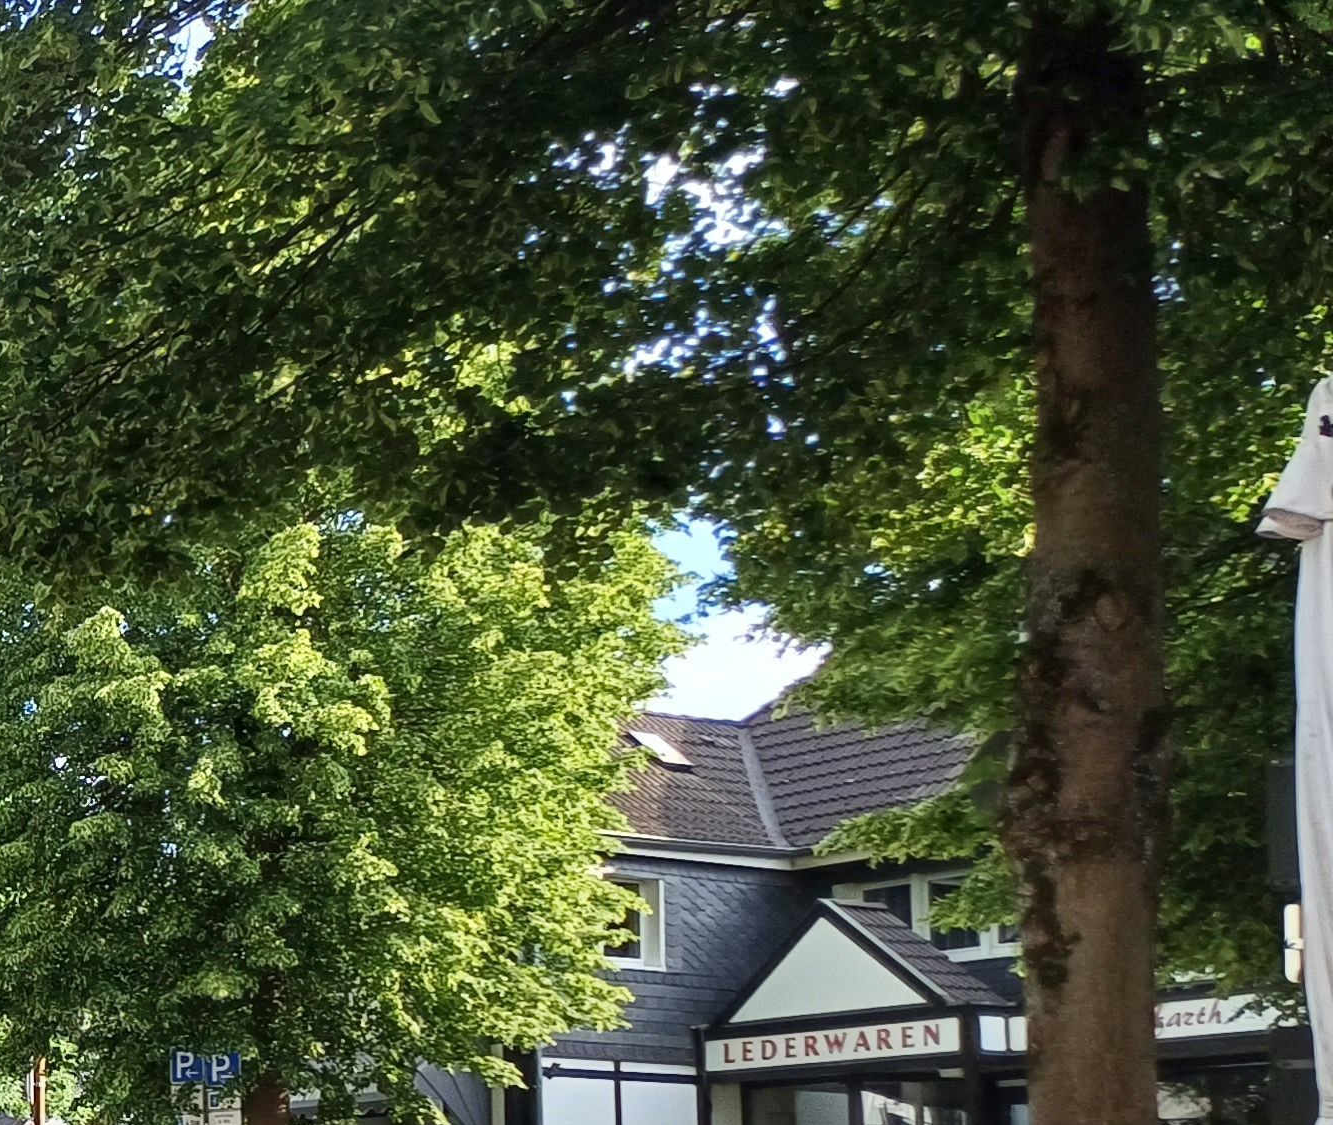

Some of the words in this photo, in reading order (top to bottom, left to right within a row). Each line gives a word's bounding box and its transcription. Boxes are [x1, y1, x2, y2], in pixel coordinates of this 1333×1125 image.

[723, 1023, 941, 1064] LEDERWAREN
[176, 1052, 194, 1078] P
[212, 1054, 230, 1082] P
